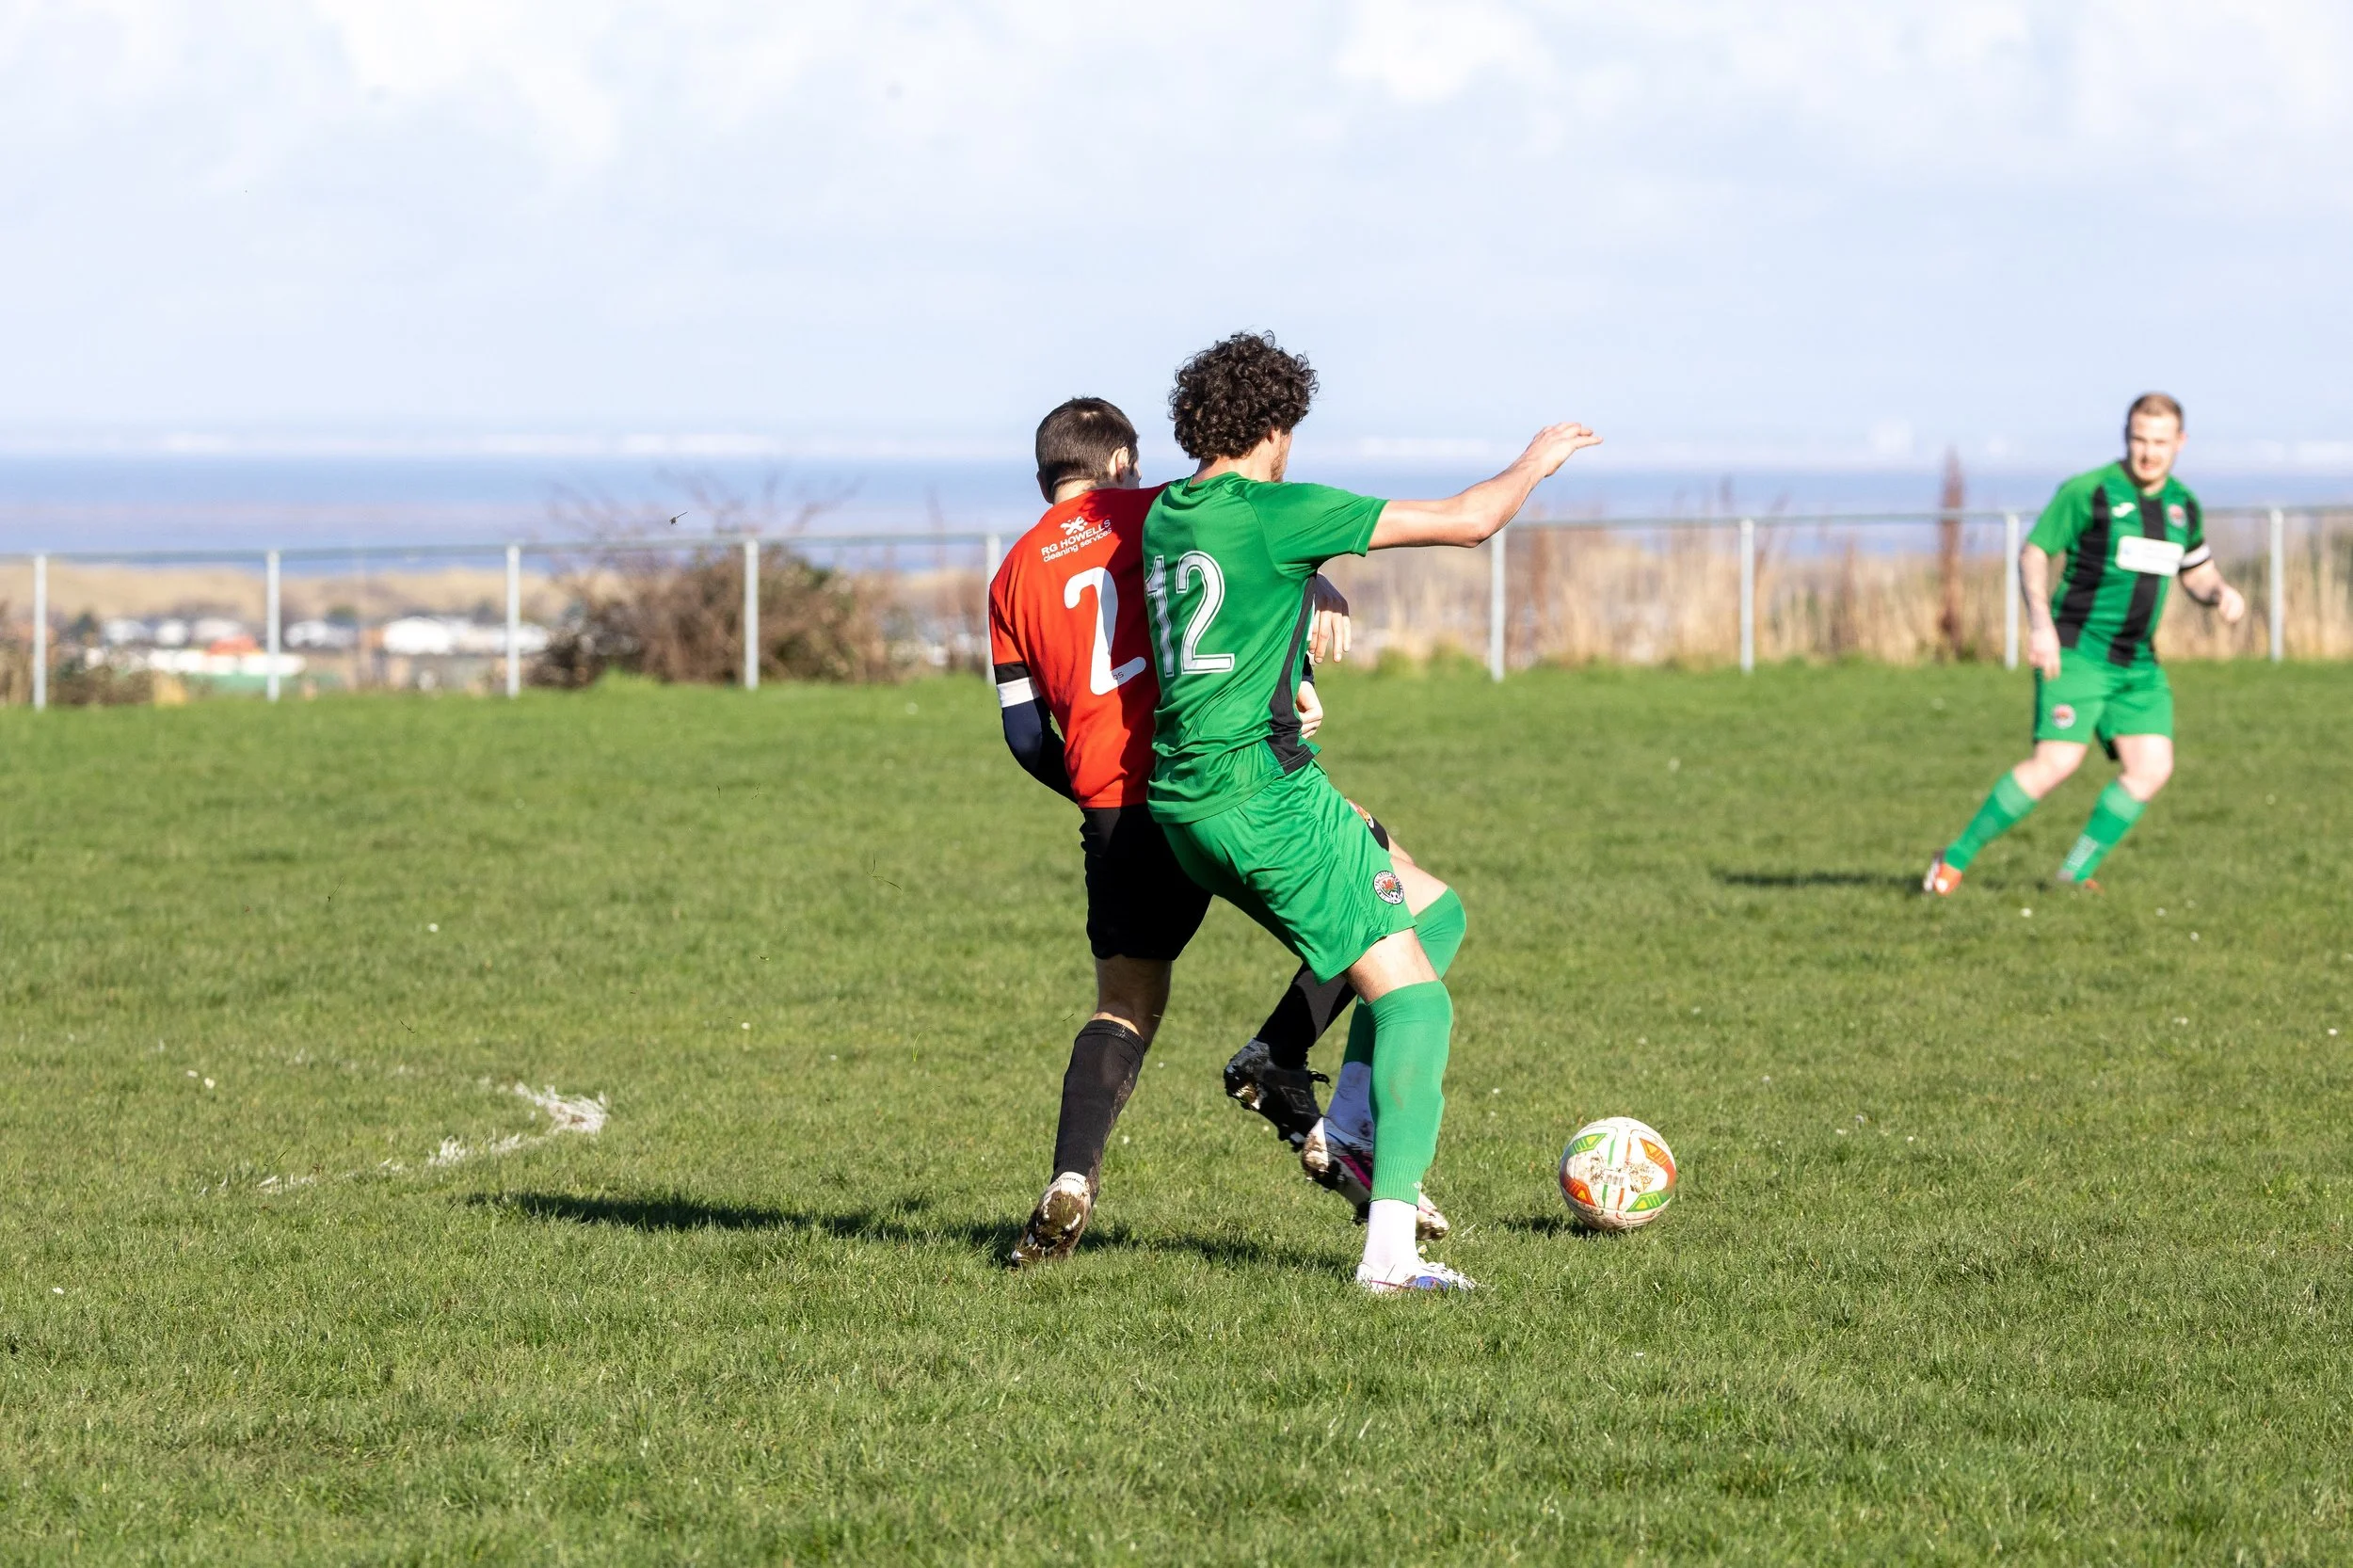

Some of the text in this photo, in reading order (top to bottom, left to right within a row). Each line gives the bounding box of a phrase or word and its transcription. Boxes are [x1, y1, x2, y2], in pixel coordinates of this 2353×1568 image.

[1041, 520, 1111, 556] RG HOWELLS
[1043, 527, 1112, 563] cleaning services
[1064, 566, 1146, 696] 2
[1144, 550, 1235, 678] 12
